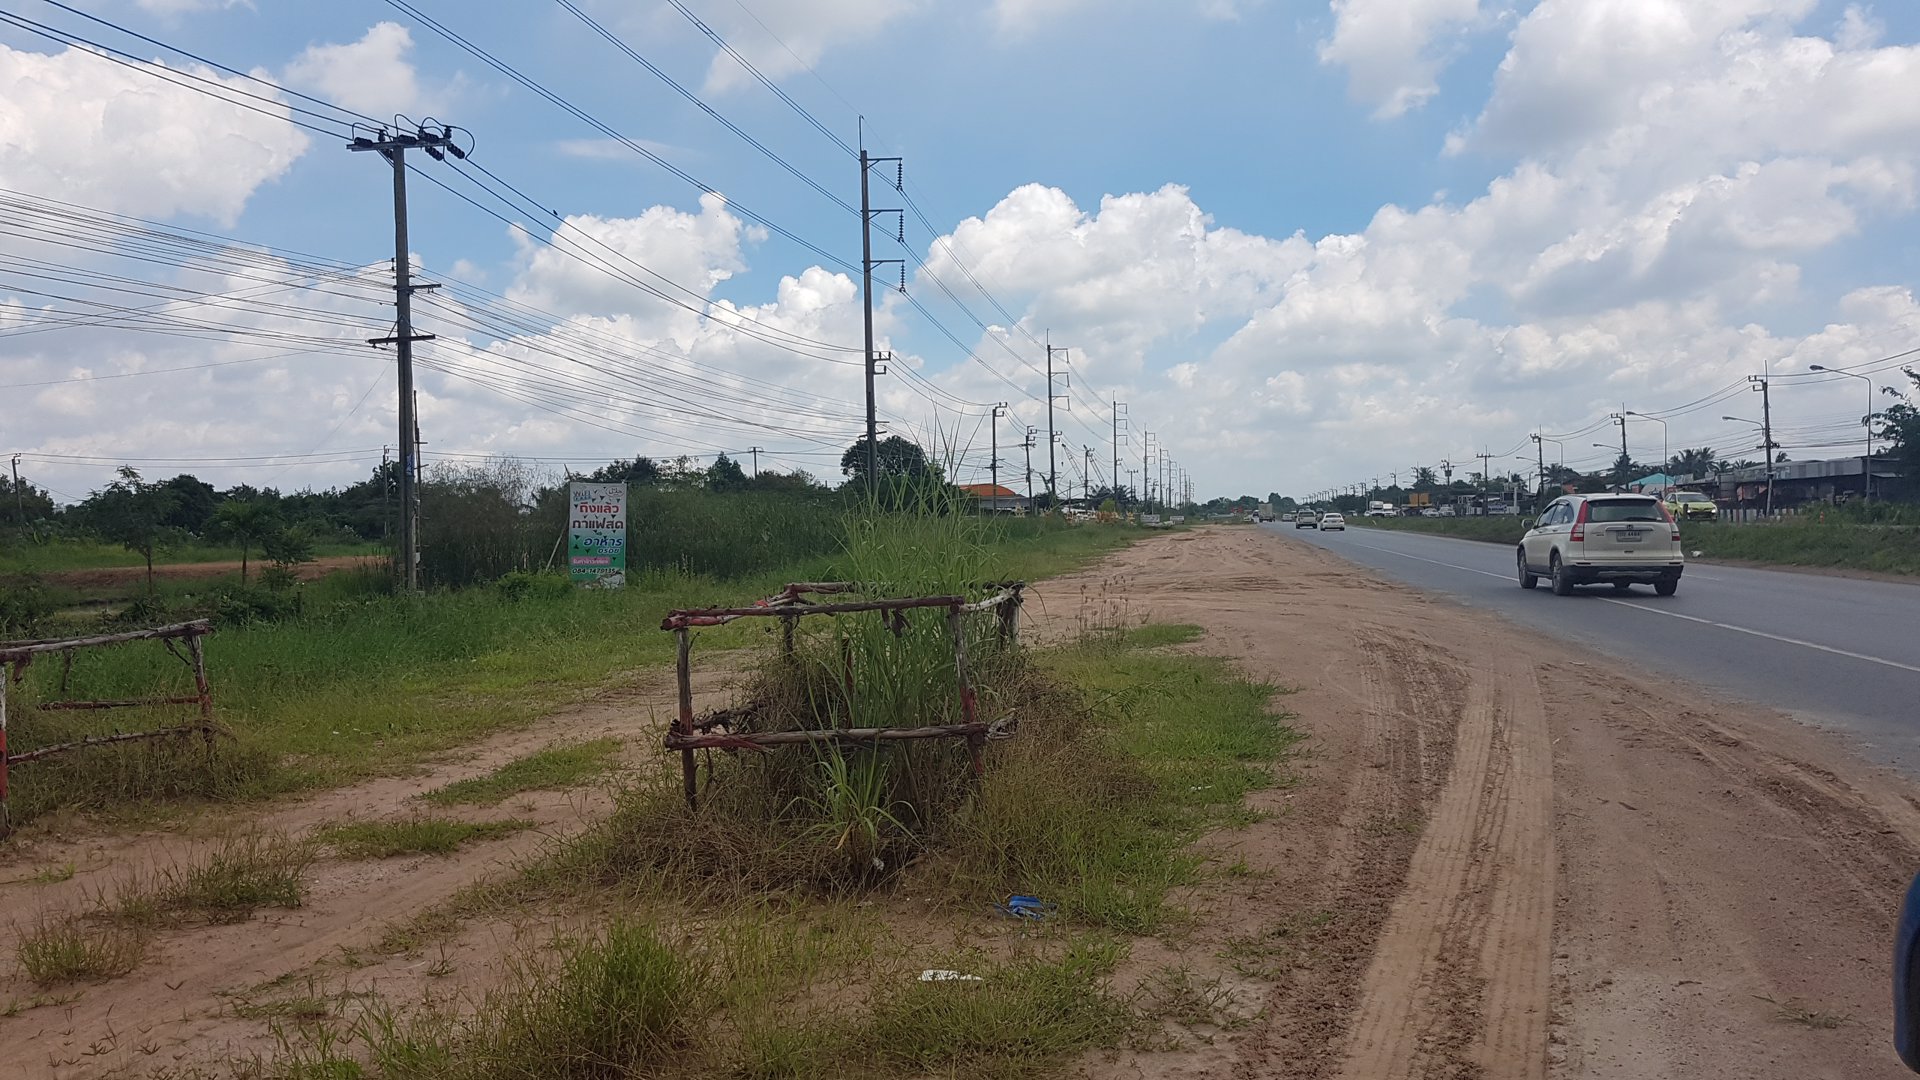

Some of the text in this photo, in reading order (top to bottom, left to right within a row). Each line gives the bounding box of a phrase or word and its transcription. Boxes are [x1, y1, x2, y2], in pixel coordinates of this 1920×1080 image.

[579, 502, 619, 513] ถึงแล้ว
[572, 518, 624, 529] กาแฟสด
[583, 538, 623, 546] อาหาร
